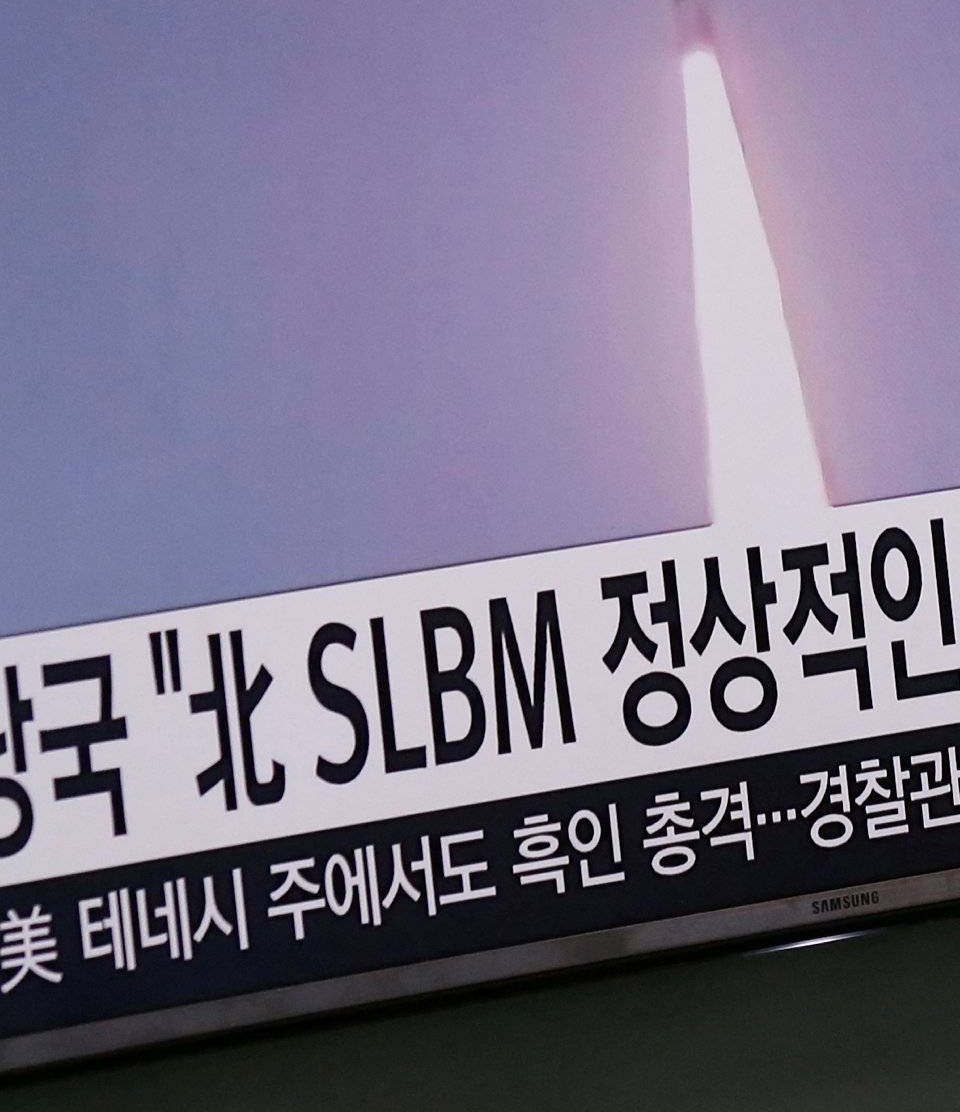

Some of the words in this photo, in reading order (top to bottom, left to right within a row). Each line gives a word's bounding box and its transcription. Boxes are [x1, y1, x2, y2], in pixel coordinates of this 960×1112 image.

[307, 589, 577, 785] SLBM
[0, 904, 63, 993] 美
[78, 867, 249, 971] 테네시
[267, 829, 497, 941] 주에서도
[512, 803, 626, 894] 흑인
[811, 890, 881, 915] SAMSUNG
